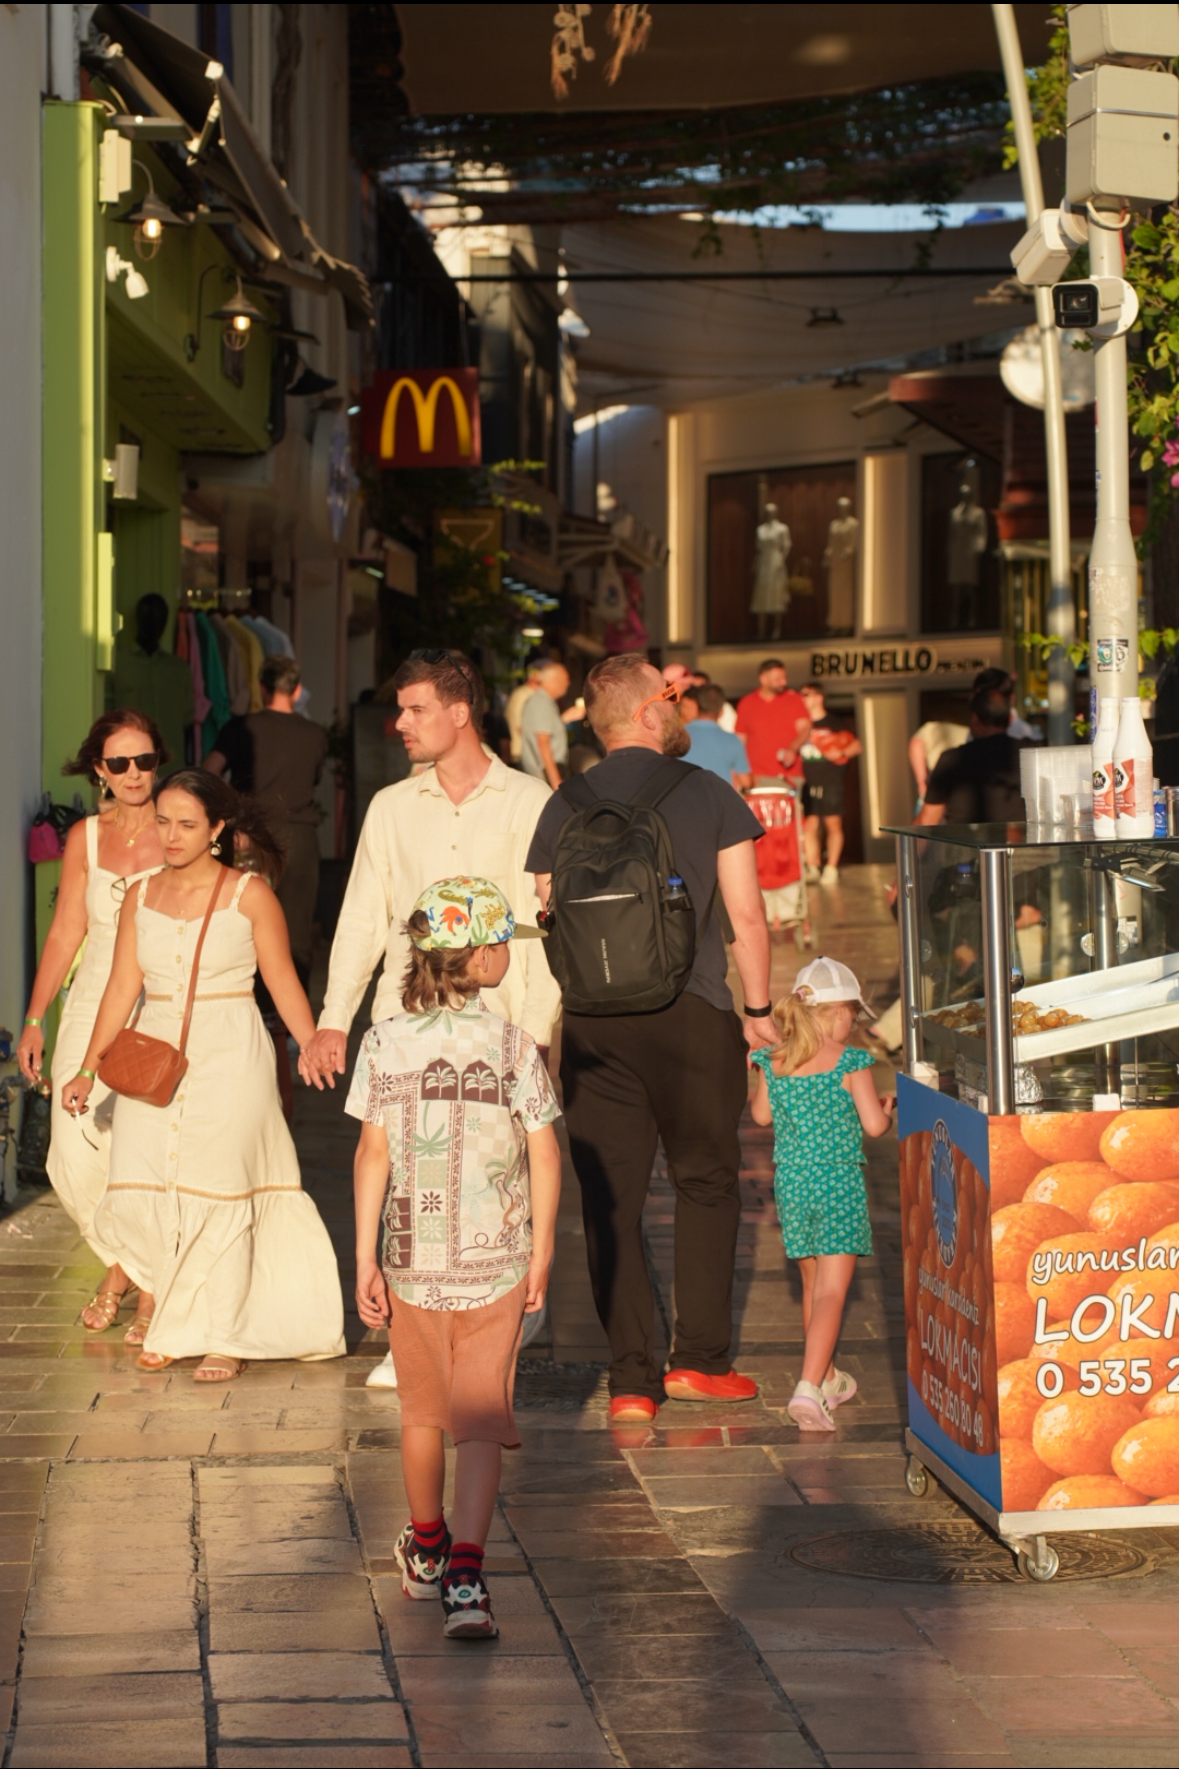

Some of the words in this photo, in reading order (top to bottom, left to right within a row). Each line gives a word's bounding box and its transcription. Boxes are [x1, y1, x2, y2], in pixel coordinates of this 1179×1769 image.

[811, 648, 932, 676] BRUNELLO
[1032, 1236, 1179, 1285] yunuslar
[919, 1307, 982, 1394] LOKMACISI
[1036, 1361, 1065, 1399] 0
[1078, 1358, 1153, 1397] 535
[922, 1368, 928, 1400] 0
[929, 1373, 943, 1414] 535
[944, 1386, 960, 1427] 260
[973, 1410, 984, 1448] 48
